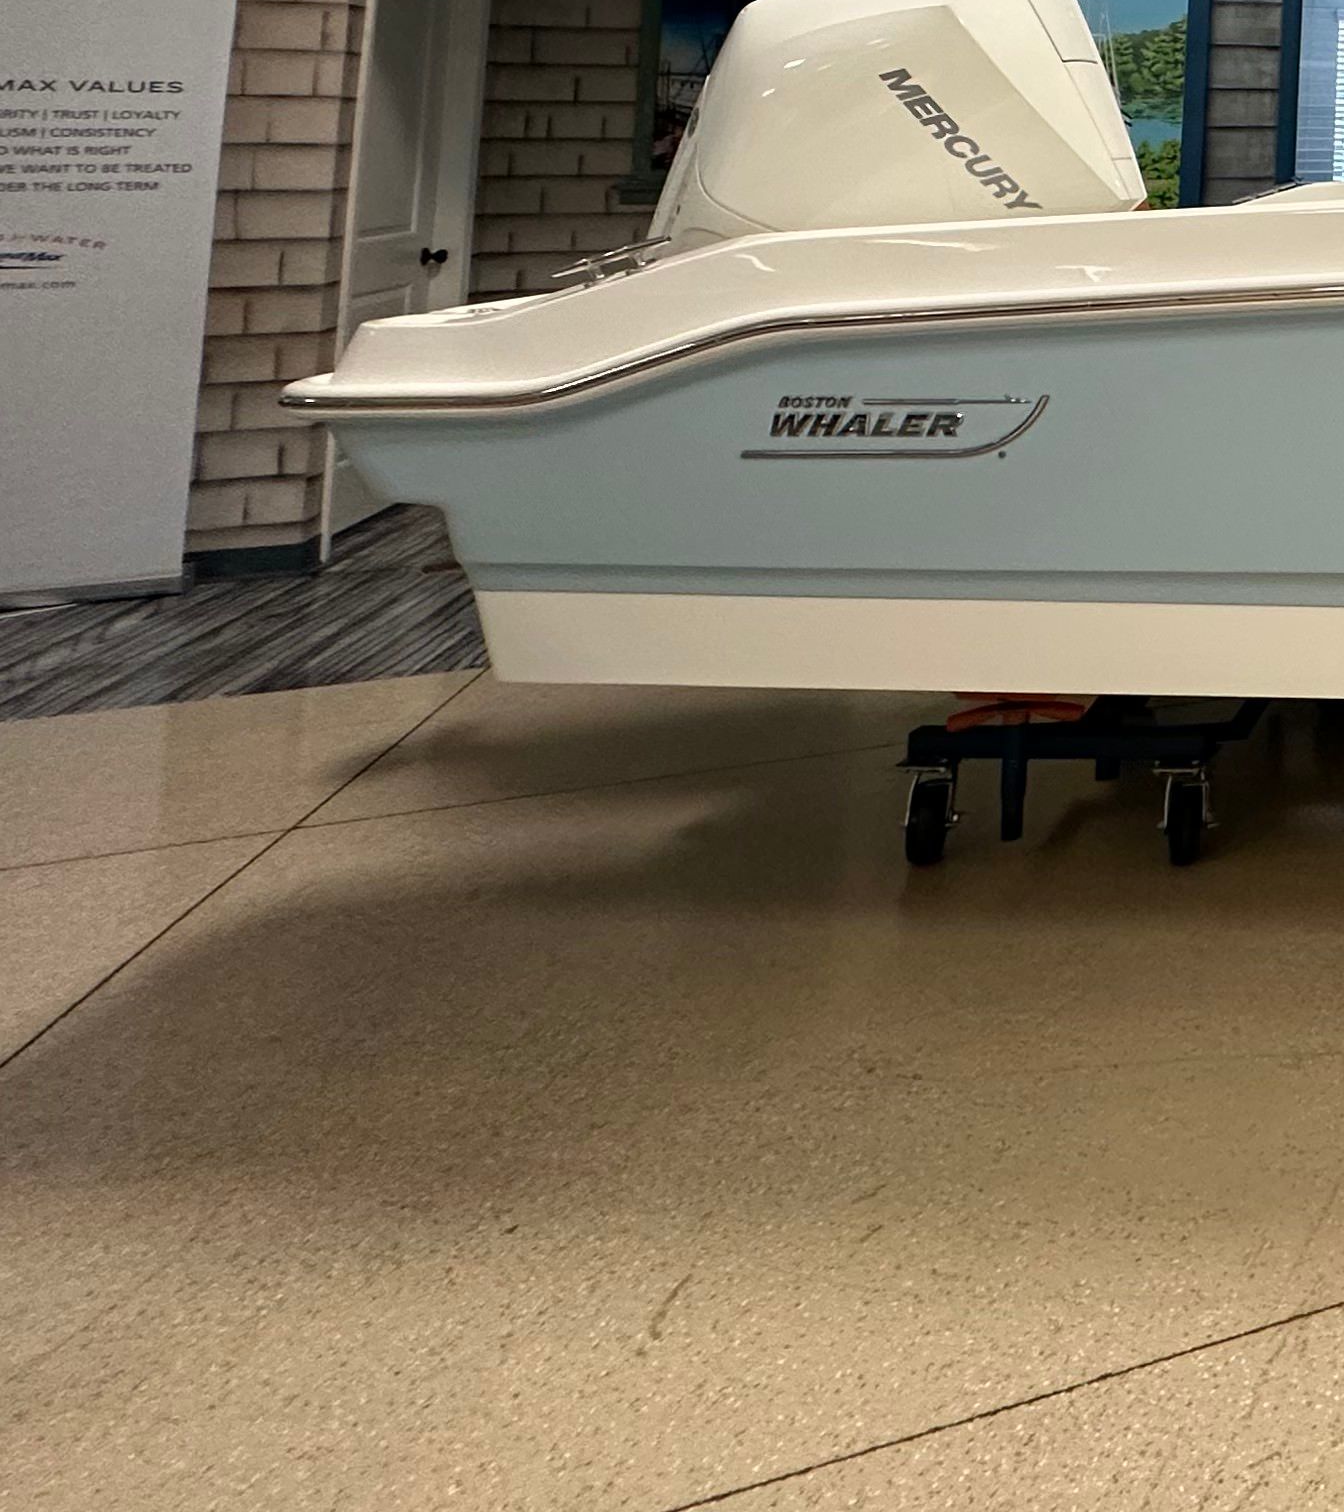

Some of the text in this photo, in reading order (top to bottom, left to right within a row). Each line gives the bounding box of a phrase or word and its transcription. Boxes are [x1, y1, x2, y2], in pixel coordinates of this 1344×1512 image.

[69, 79, 184, 94] VALUES
[52, 110, 99, 120] TRUST
[112, 110, 182, 120] LOYALTY
[50, 128, 157, 138] CONSISTENCY
[878, 67, 1043, 209] MERCURY
[13, 145, 62, 156] WHAT
[66, 145, 80, 156] IS
[84, 145, 132, 156] RIGHT
[21, 163, 70, 174] WANT
[76, 163, 97, 174] TO
[101, 163, 121, 174] BE
[124, 163, 192, 174] TREATED
[33, 181, 63, 192] THE
[67, 181, 112, 192] LONG
[116, 181, 159, 191] TERM
[31, 234, 106, 249] WATER
[778, 395, 853, 409] BOSTON
[770, 412, 964, 438] WHALER
